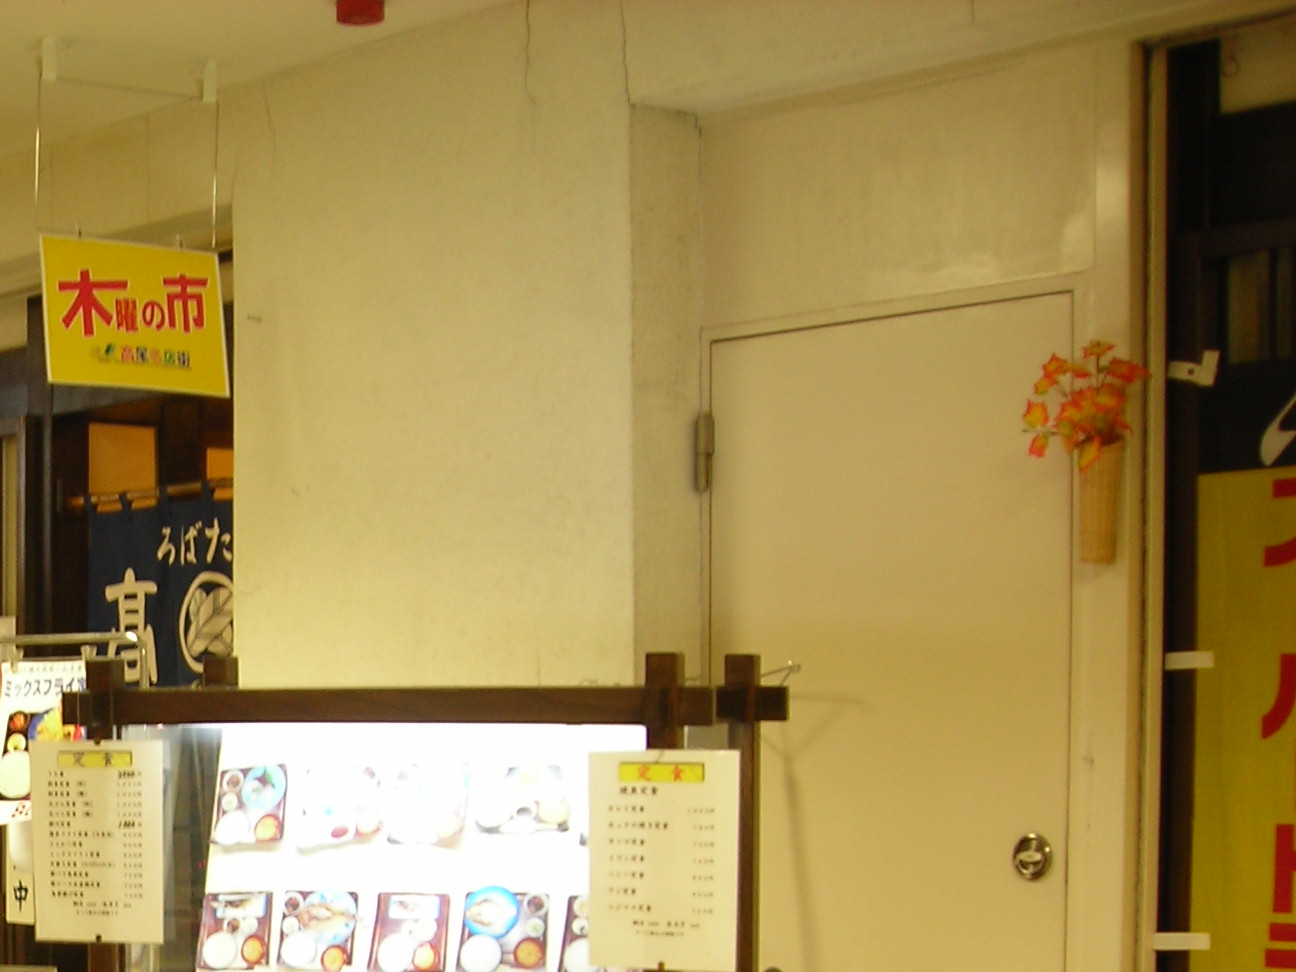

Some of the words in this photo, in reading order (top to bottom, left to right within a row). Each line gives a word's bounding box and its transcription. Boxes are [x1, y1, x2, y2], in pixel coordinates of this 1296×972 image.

[58, 268, 208, 337] 木曜の市
[637, 765, 685, 781] 定食
